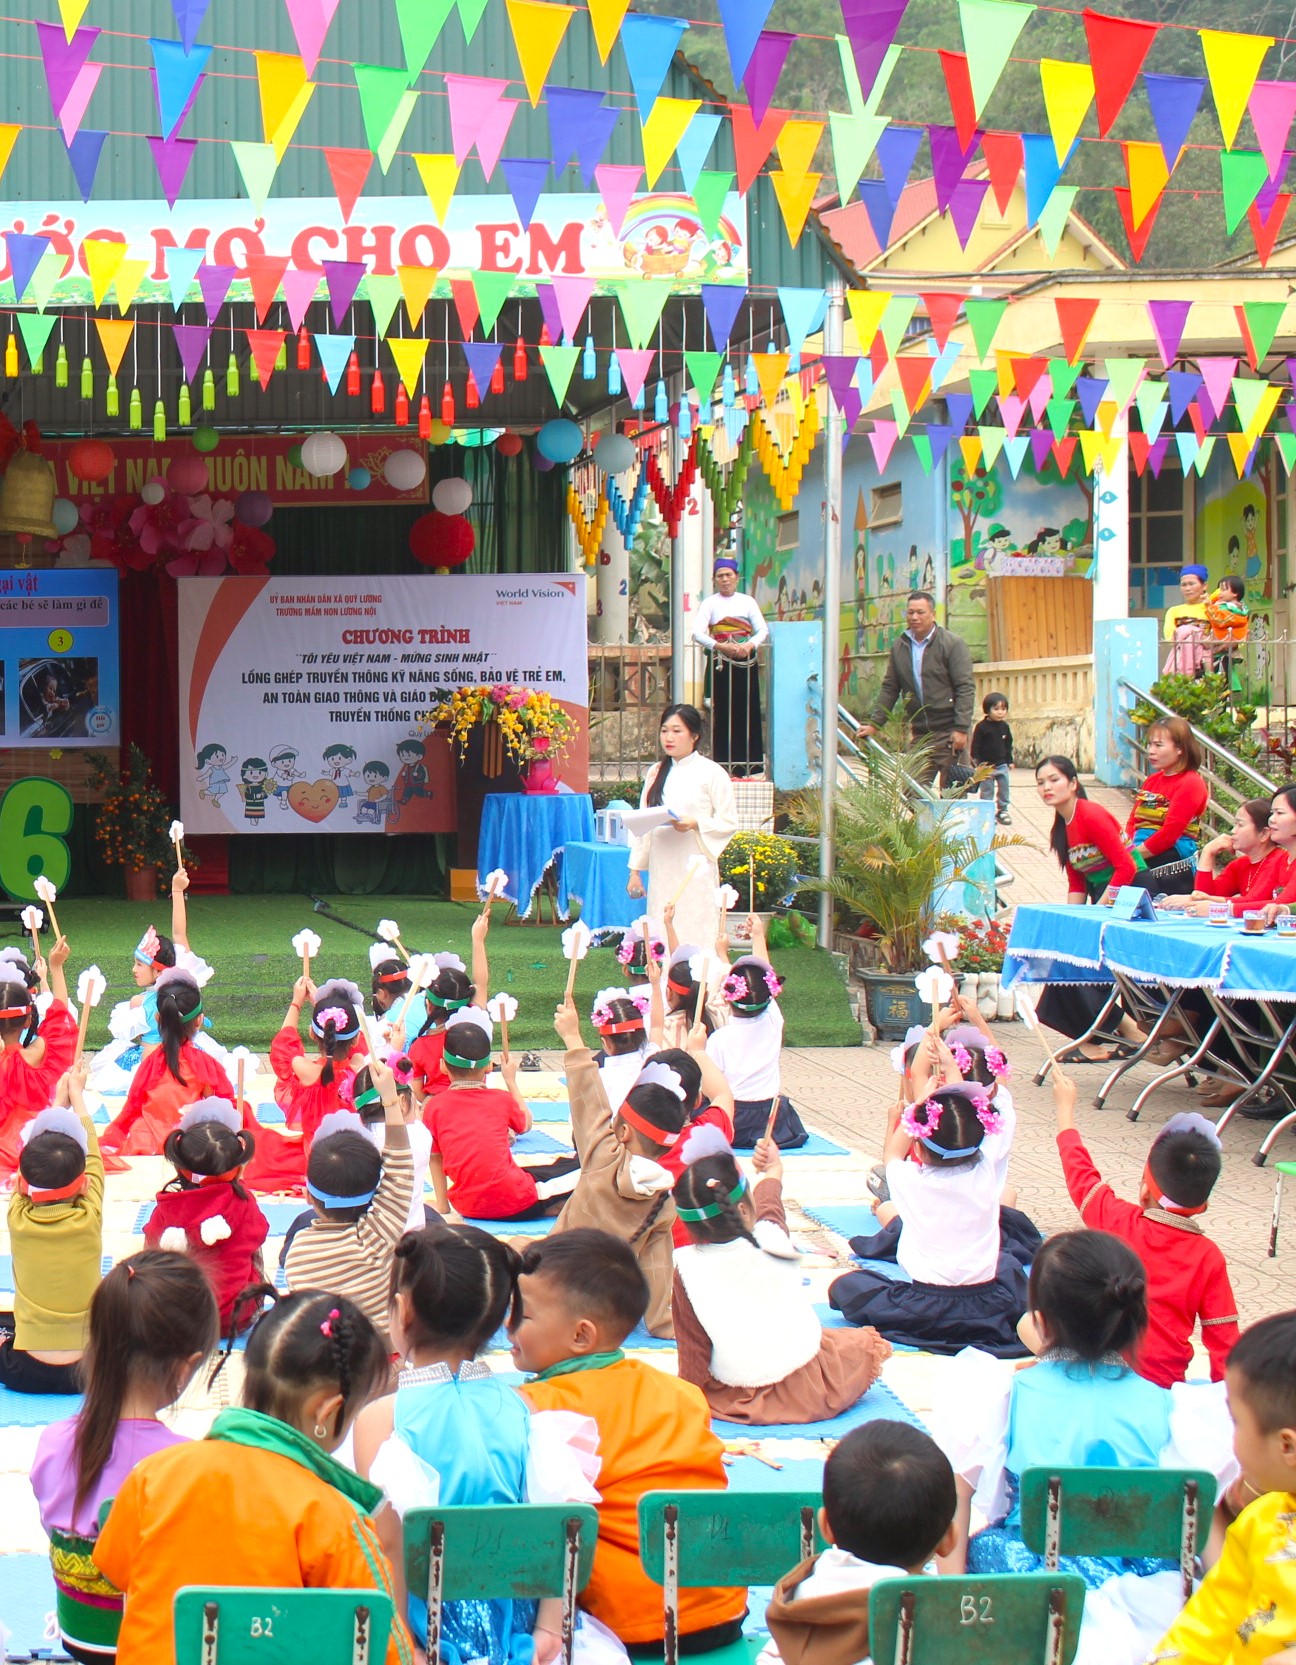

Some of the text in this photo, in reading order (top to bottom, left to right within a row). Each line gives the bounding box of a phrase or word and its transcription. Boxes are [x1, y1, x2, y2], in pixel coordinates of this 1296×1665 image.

[291, 224, 451, 276] CHO
[475, 222, 586, 275] EM
[687, 498, 699, 516] 2
[18, 572, 39, 596] vật
[496, 588, 565, 598] World Vision
[0, 600, 18, 610] các
[22, 600, 35, 610] bé
[52, 599, 73, 610] làm
[76, 599, 86, 612] gì
[281, 595, 295, 604] BAN
[57, 636, 64, 647] 3
[342, 624, 470, 645] CHƯƠNG TRÌNH
[321, 652, 340, 664] YÊU
[342, 652, 365, 665] VIỆT
[366, 653, 391, 664] NAM
[434, 653, 459, 663] SINH
[274, 670, 303, 684] GHÉP
[352, 669, 388, 684] THÔNG
[408, 668, 440, 683] NĂNG
[443, 667, 477, 684] SỐNG,
[480, 666, 503, 683] BẢO
[505, 668, 520, 685] VỆ
[522, 665, 542, 683] TRẺ
[545, 670, 566, 683] EM,
[263, 692, 279, 703] AN
[281, 690, 311, 703] TOÀN
[314, 691, 340, 703] GIAO
[343, 689, 380, 703] THÔNG
[382, 689, 397, 703] VÀ
[400, 688, 426, 703] GIÁO
[374, 706, 411, 722] THỐNG
[888, 999, 909, 1019] 福
[960, 1595, 994, 1624] B2
[250, 1616, 274, 1639] B2
